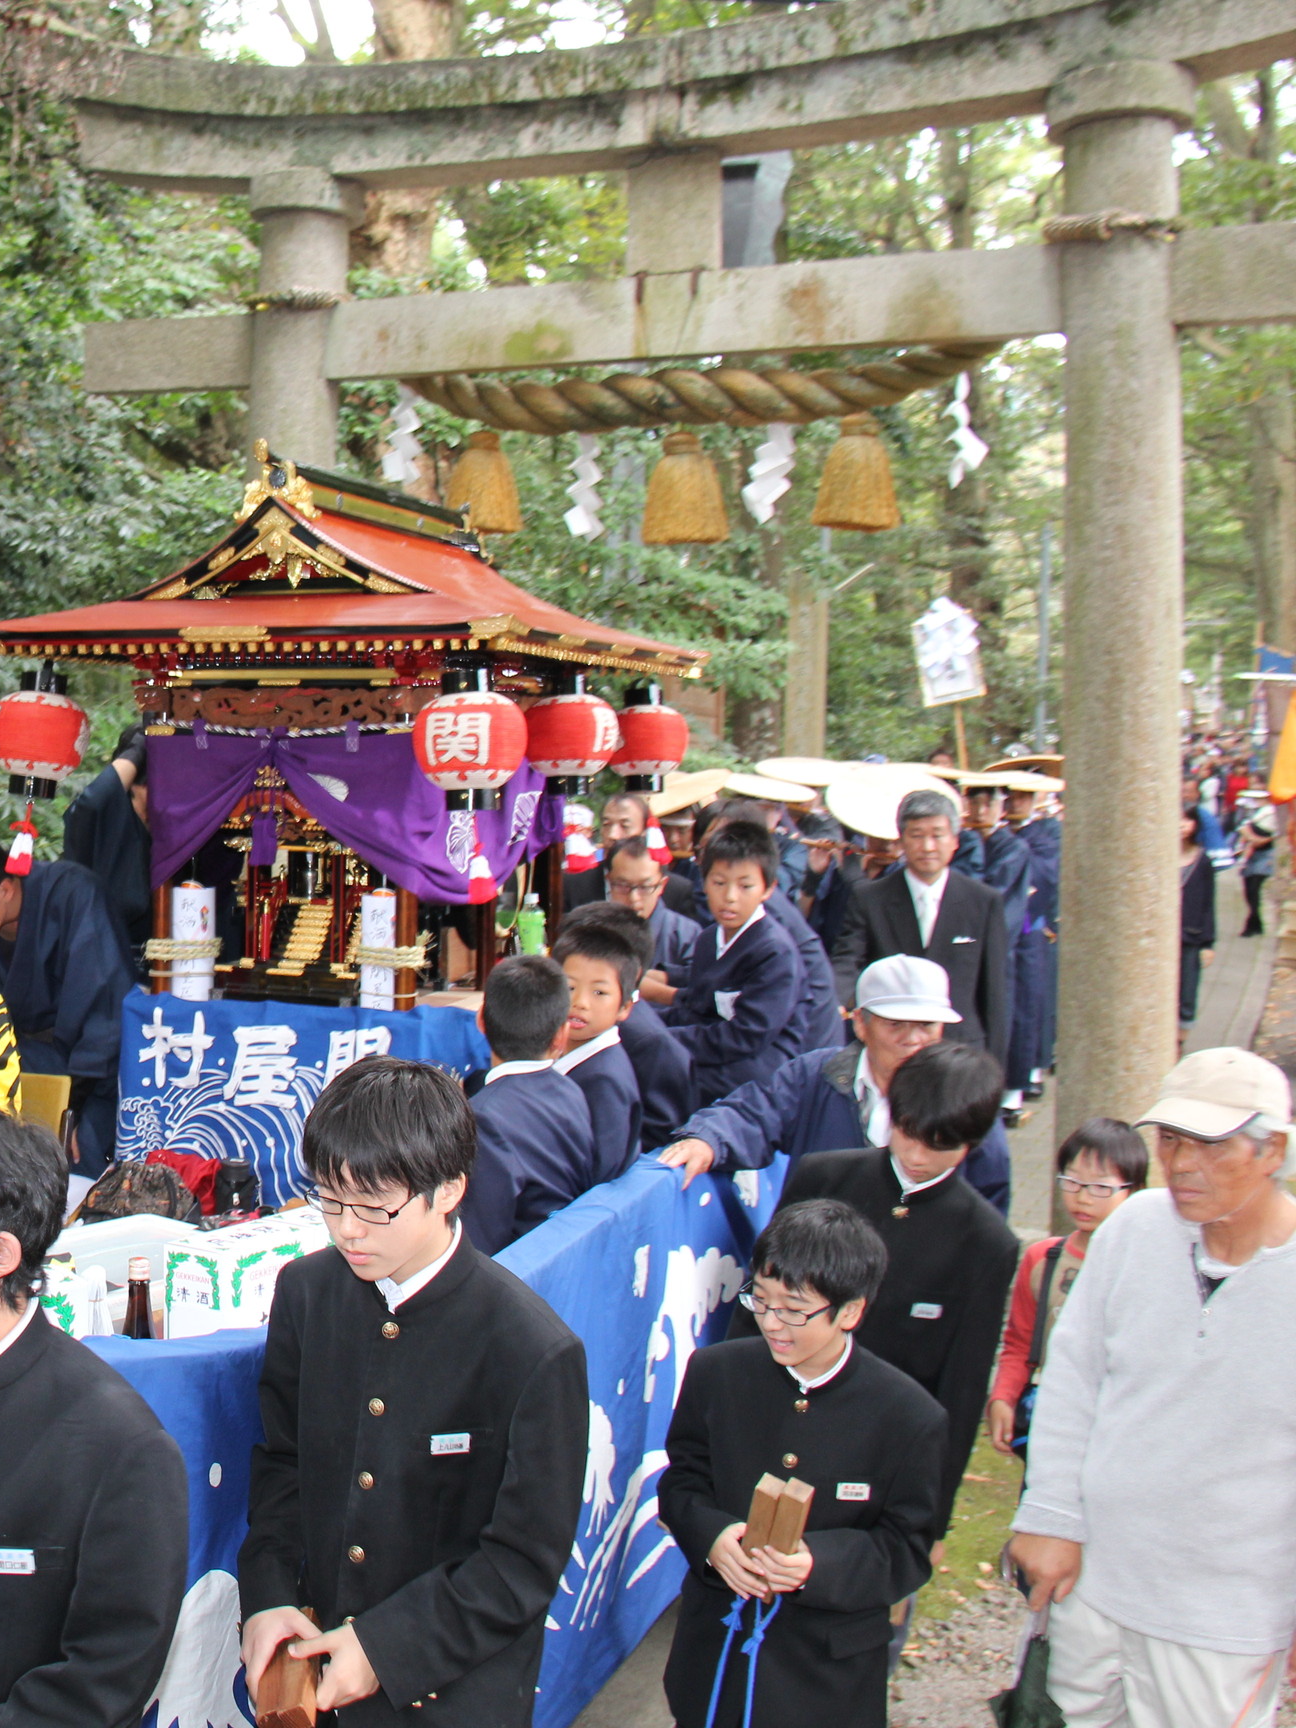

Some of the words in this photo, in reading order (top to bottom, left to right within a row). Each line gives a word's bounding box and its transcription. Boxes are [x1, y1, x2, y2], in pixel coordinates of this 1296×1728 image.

[425, 712, 491, 766] 関
[175, 1271, 210, 1285] GEKKEIKAN
[176, 1286, 210, 1305] 清酒
